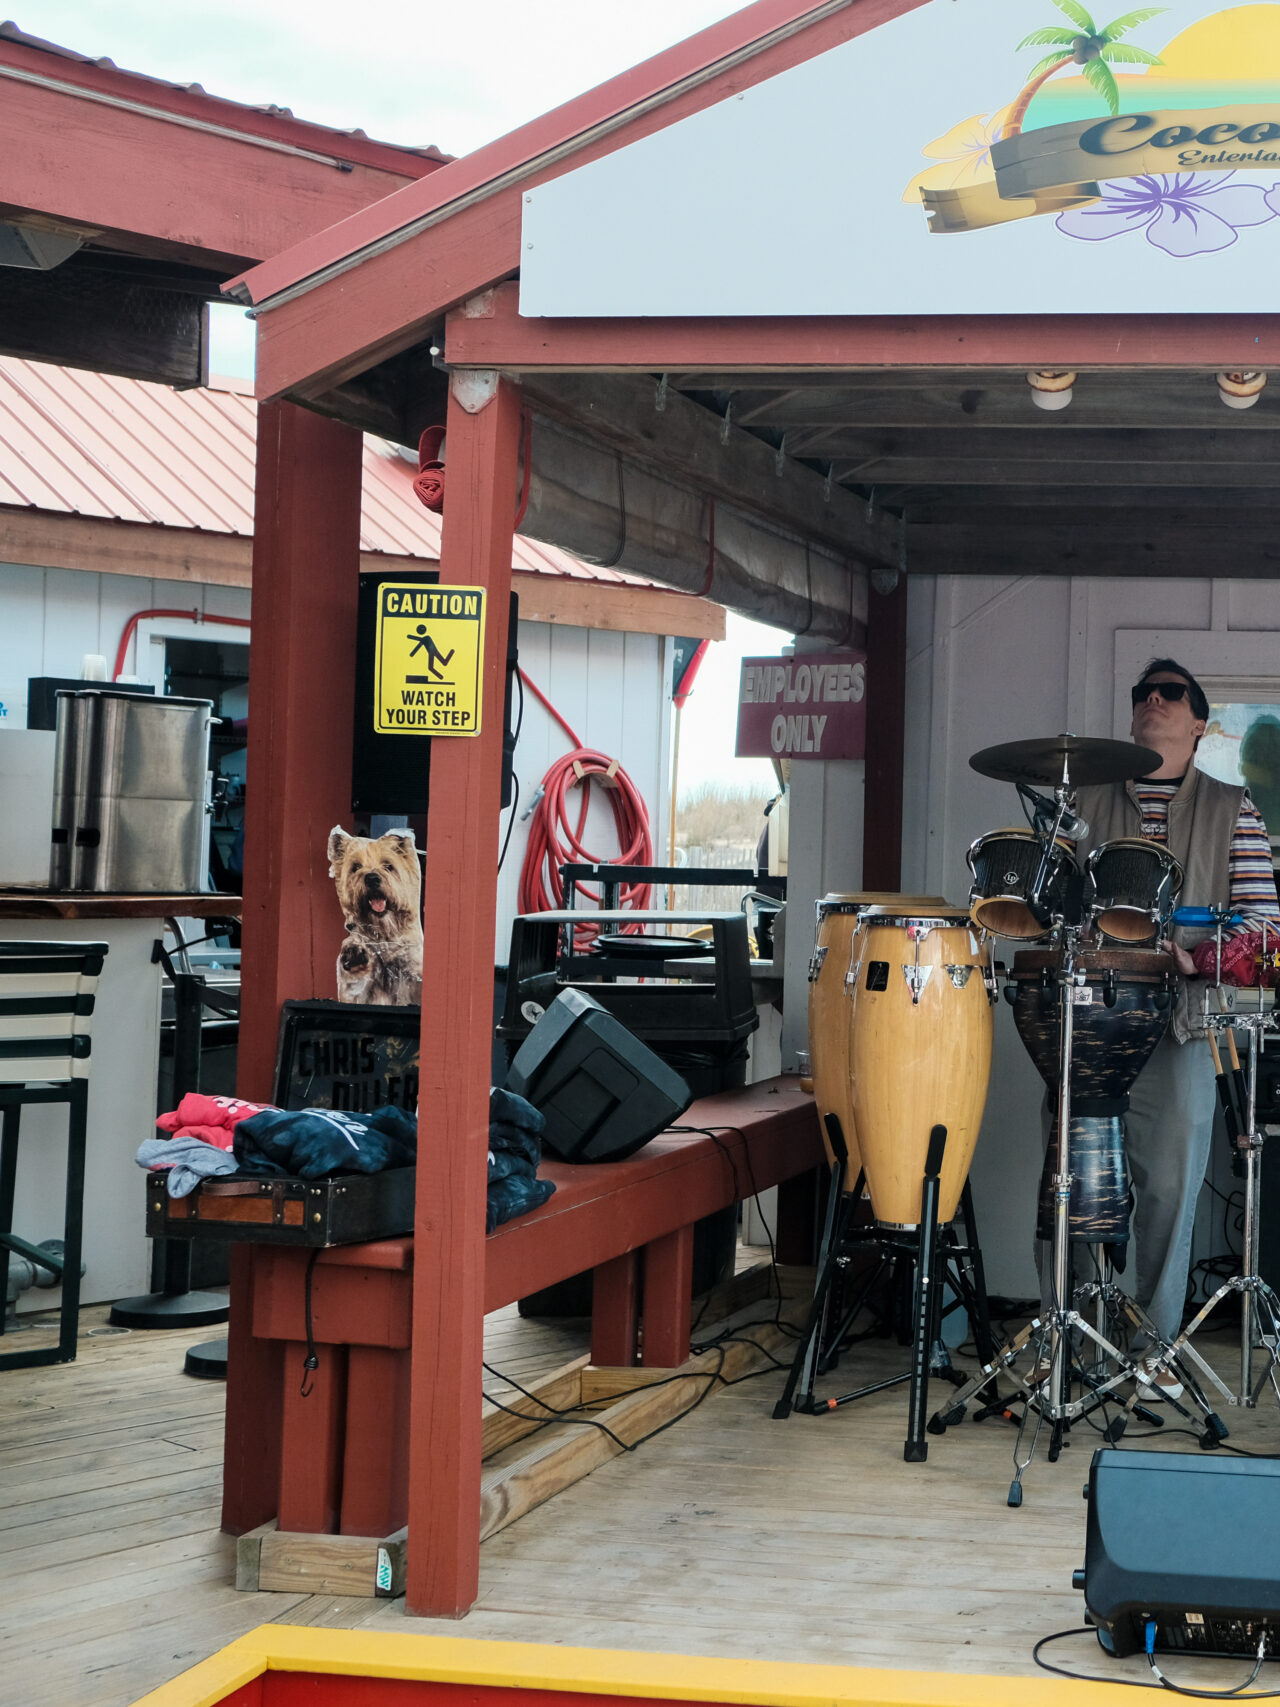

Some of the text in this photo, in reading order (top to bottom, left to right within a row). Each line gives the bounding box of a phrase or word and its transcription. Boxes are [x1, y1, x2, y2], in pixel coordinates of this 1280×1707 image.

[387, 592, 477, 616] CAUTION
[401, 690, 456, 707] WATCH
[741, 662, 865, 704] EMPLOYEES
[386, 708, 471, 726] YOUR STEP
[770, 714, 828, 753] ONLY
[298, 1037, 376, 1077] CHRIS
